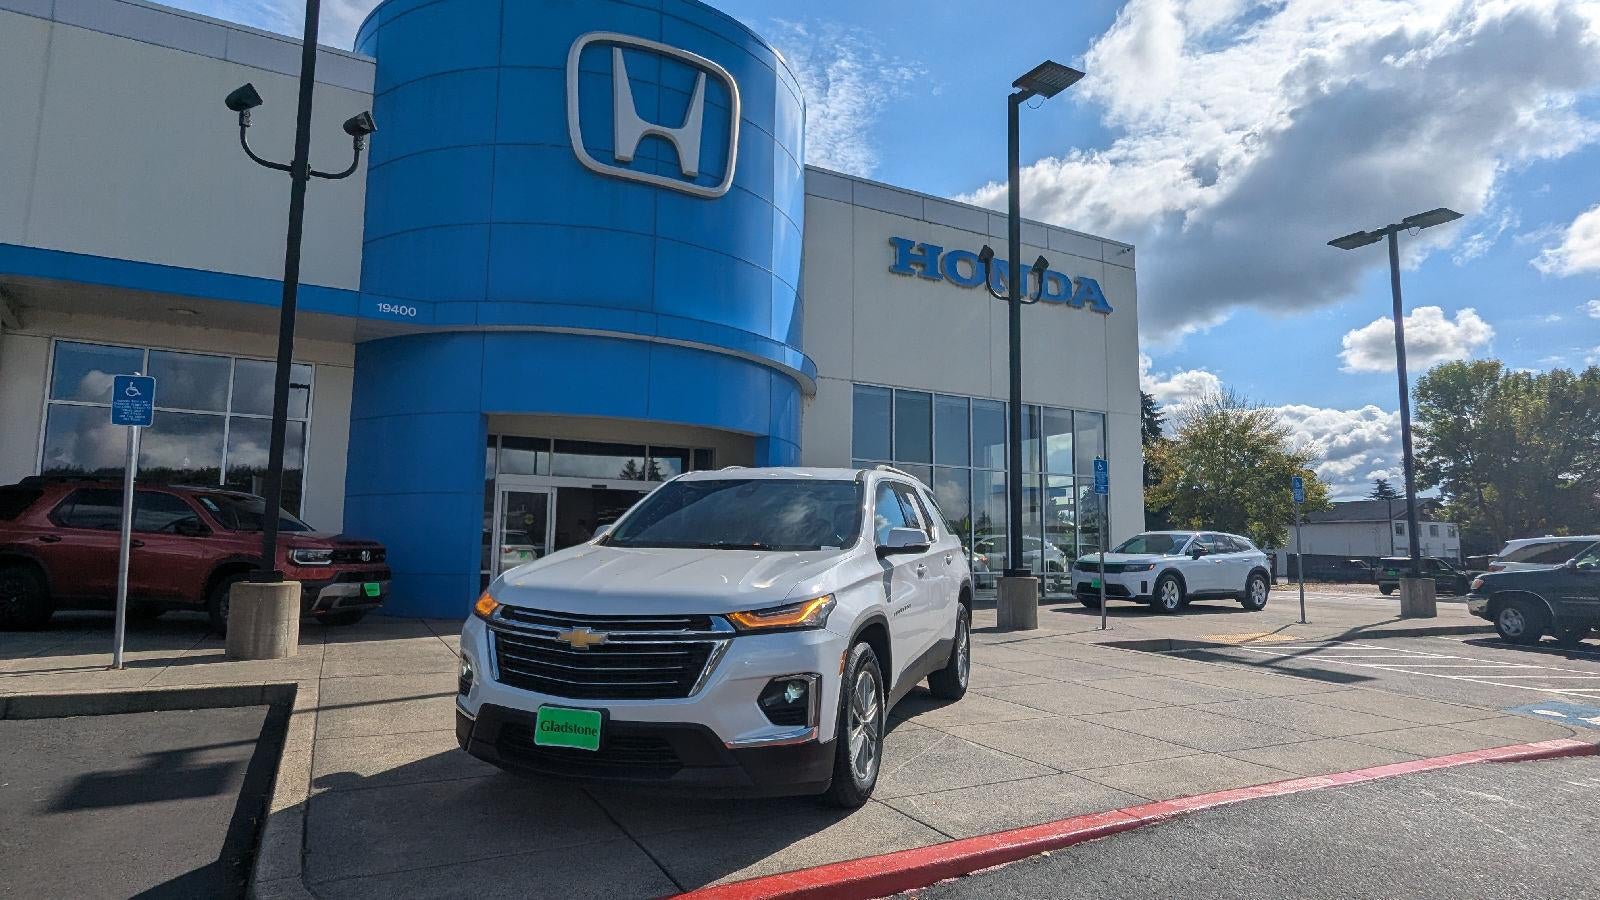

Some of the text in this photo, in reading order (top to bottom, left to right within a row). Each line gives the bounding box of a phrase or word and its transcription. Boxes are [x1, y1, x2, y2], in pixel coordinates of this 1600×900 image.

[889, 236, 1113, 314] HONDA
[377, 303, 417, 317] 19400
[541, 720, 598, 737] Gladstone
